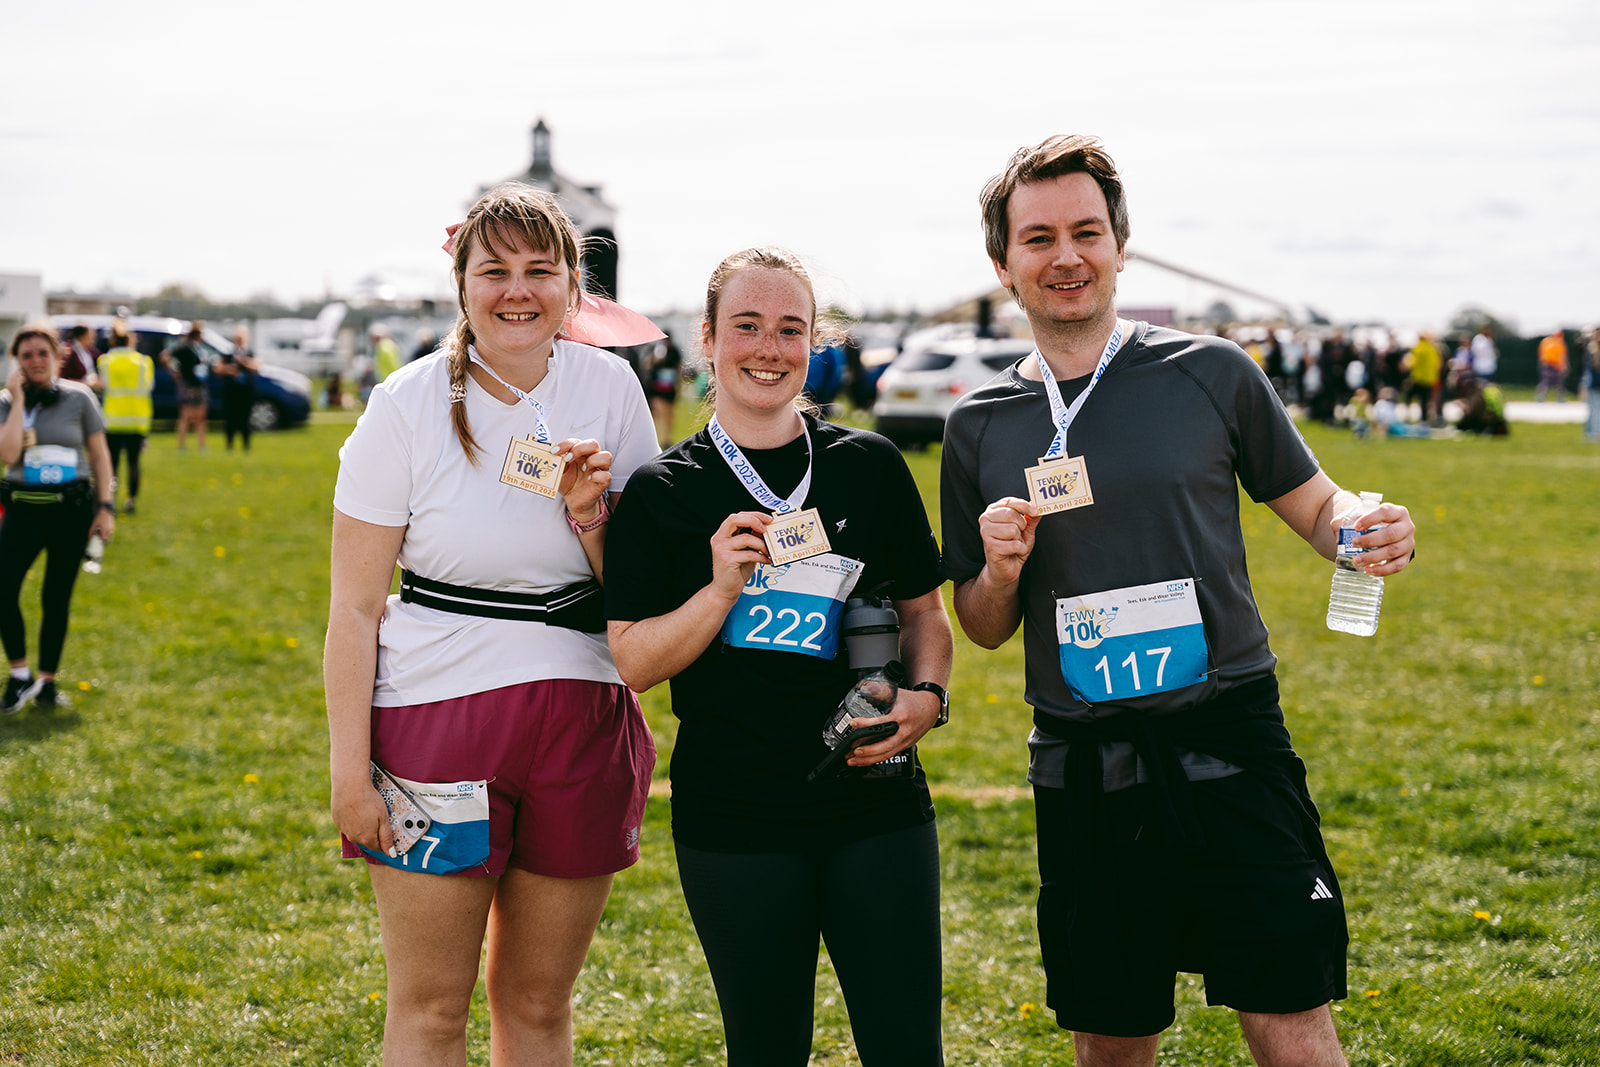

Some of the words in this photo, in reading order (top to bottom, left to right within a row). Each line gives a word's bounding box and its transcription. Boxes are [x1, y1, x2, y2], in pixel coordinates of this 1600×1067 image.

[518, 451, 543, 465] TEWV
[720, 439, 739, 462] 10k
[734, 459, 758, 485] 2025
[516, 460, 542, 480] 10k
[503, 475, 519, 485] 19th
[519, 481, 539, 491] April
[538, 486, 557, 498] 2025
[1036, 475, 1062, 488] TEWV
[1039, 482, 1070, 500] 10k
[1038, 506, 1052, 514] 9th
[1053, 500, 1073, 511] April
[1074, 496, 1093, 506] 2025
[774, 525, 799, 538] TEWV
[777, 532, 808, 550] 10k
[774, 555, 791, 564] 19th
[792, 549, 811, 559] April
[811, 544, 831, 554] 2025
[841, 559, 854, 570] NHS
[745, 569, 769, 589] 0k
[1166, 583, 1184, 592] NHS
[1064, 609, 1095, 624] TEWV
[745, 604, 827, 651] 222
[1064, 620, 1104, 643] 10k
[1094, 646, 1172, 695] 117
[457, 783, 474, 792] NHS
